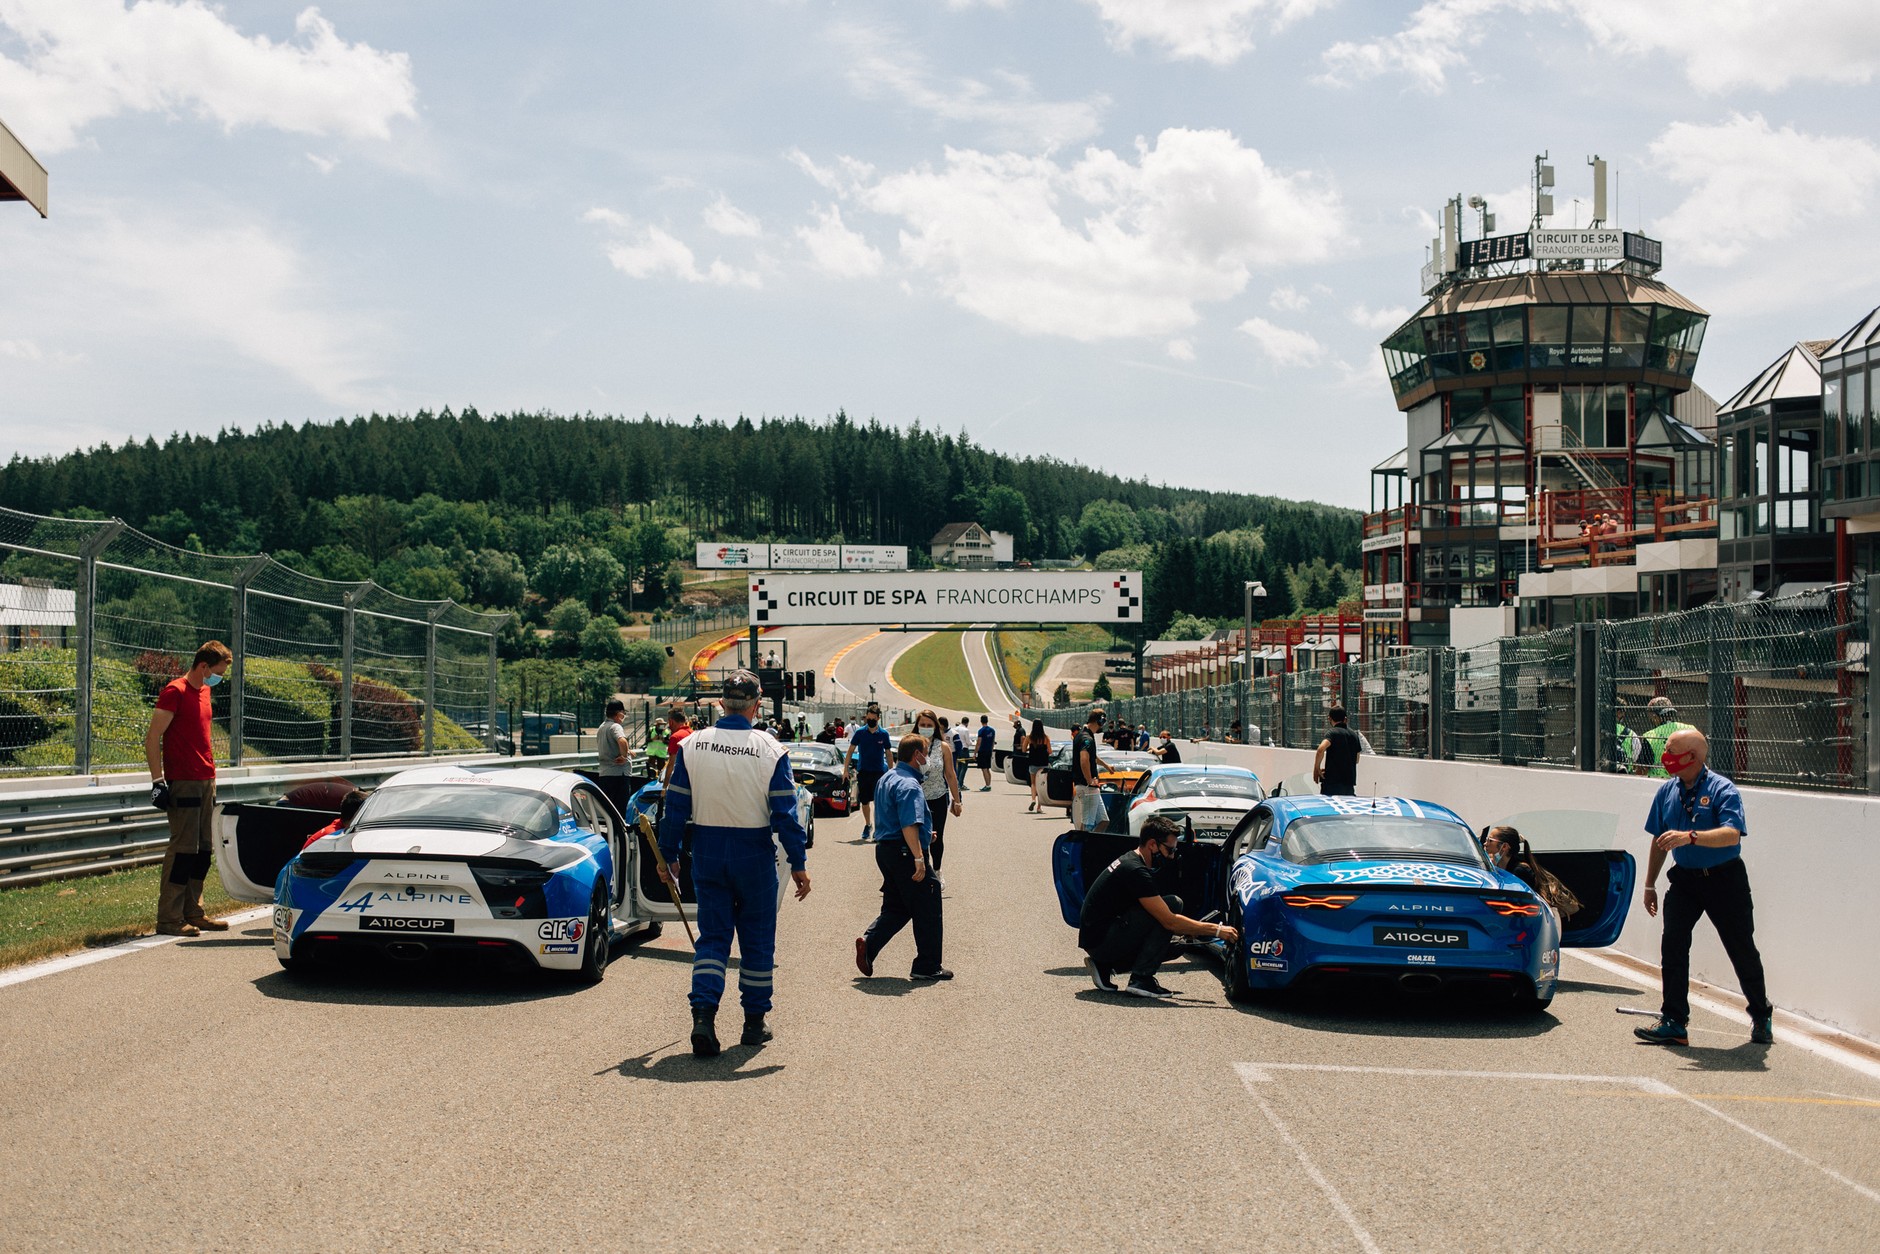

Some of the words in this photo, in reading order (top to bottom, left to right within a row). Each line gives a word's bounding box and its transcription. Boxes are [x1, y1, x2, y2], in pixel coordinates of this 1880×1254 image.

[1536, 234, 1578, 243] CIRCUIT
[1581, 234, 1595, 243] DE
[1598, 234, 1619, 243] SPA
[1536, 245, 1620, 255] FRANCORCHAMPS
[1549, 347, 1566, 356] Royal
[1609, 346, 1623, 354] Club
[1578, 356, 1602, 364] Belgium
[823, 549, 837, 557] SPA
[787, 590, 858, 607] CIRCUIT
[864, 590, 886, 606] DE
[891, 589, 927, 605] SPA
[695, 742, 710, 751] PIT
[711, 743, 760, 758] MARSHALL
[384, 872, 450, 880] ALPINE
[378, 893, 472, 904] ALPINE
[1388, 904, 1454, 912] ALPINE
[369, 918, 445, 929] A110CUP
[538, 920, 568, 940] elf
[1383, 932, 1459, 943] A110CUP
[1250, 941, 1272, 954] elf
